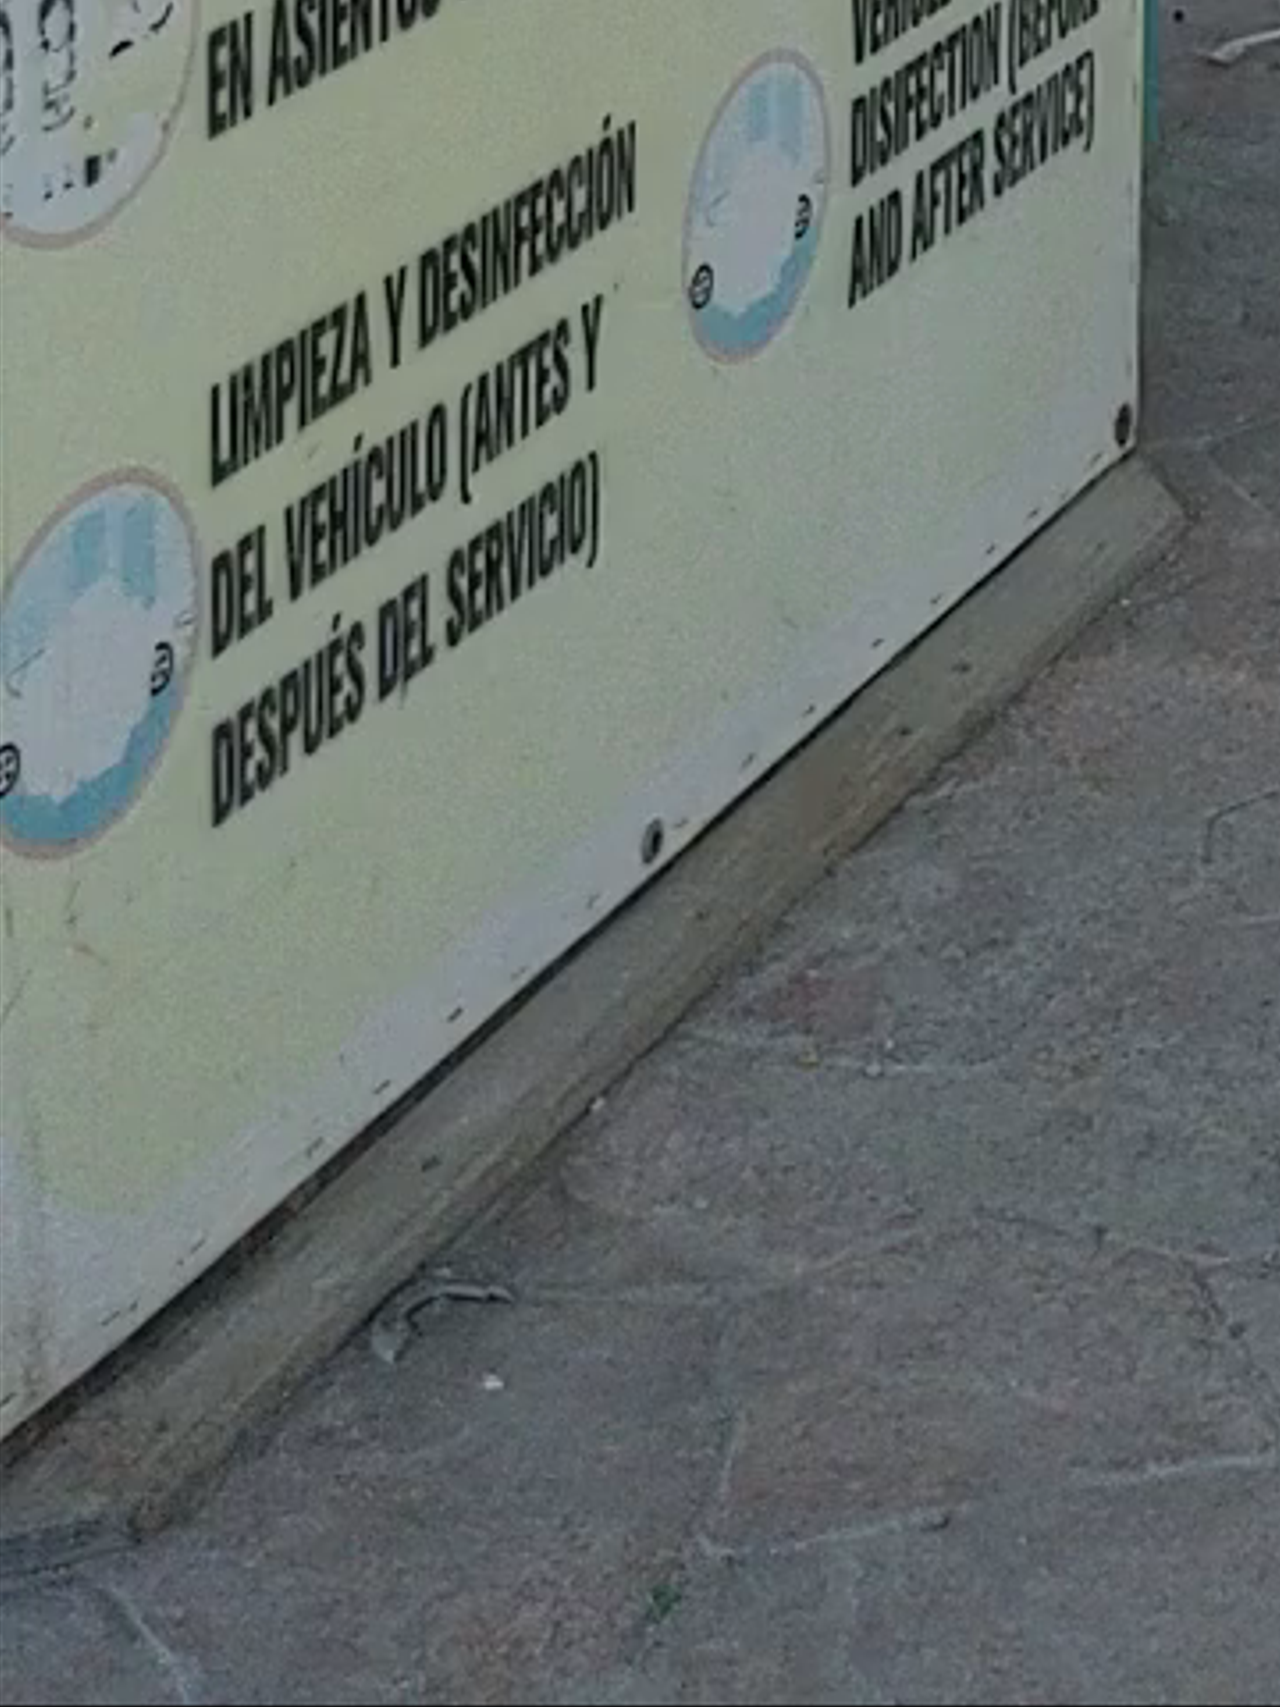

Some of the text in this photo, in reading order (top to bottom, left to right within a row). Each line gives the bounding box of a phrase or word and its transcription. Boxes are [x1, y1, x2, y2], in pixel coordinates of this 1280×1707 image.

[206, 16, 259, 140] EN
[848, 49, 1094, 309] AND AFTER SERVICE)
[208, 113, 636, 488] LIMPIEZA Y DESINFECCIÓN
[209, 294, 603, 659] DEL VEHÍCULO (ANTES Y
[212, 450, 600, 828] DESPUÉS DEL SERVICIO)
